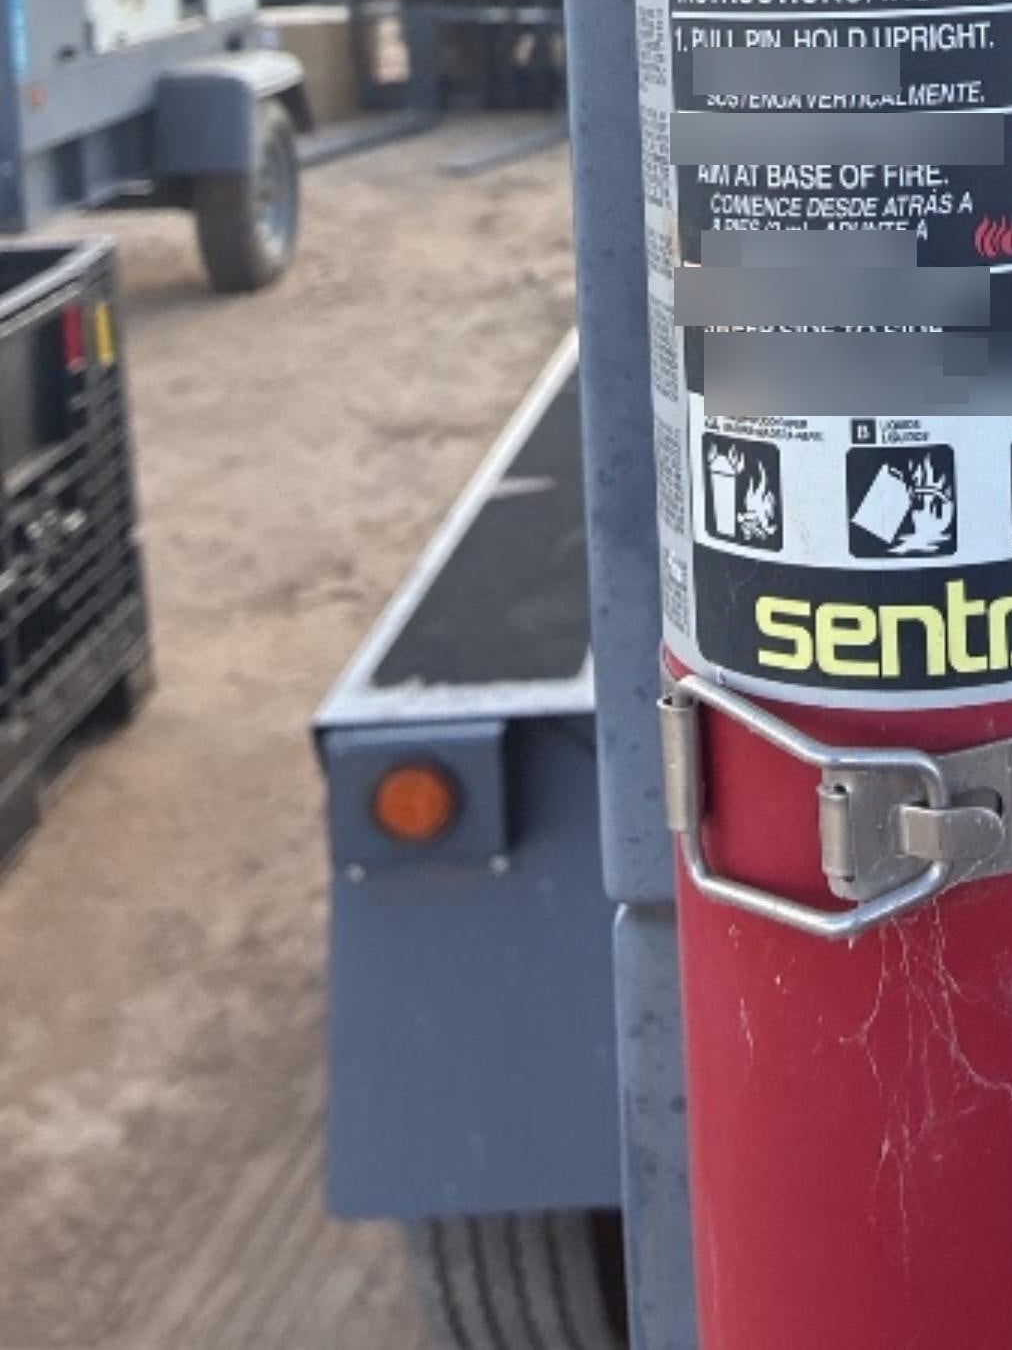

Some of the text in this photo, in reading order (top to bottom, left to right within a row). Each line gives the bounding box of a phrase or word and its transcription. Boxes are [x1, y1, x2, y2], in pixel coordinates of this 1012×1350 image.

[873, 20, 995, 52] UPRIGHT.
[767, 164, 832, 189] BASE
[840, 164, 876, 189] OF
[806, 196, 879, 218] DESDE
[957, 191, 973, 214] A
